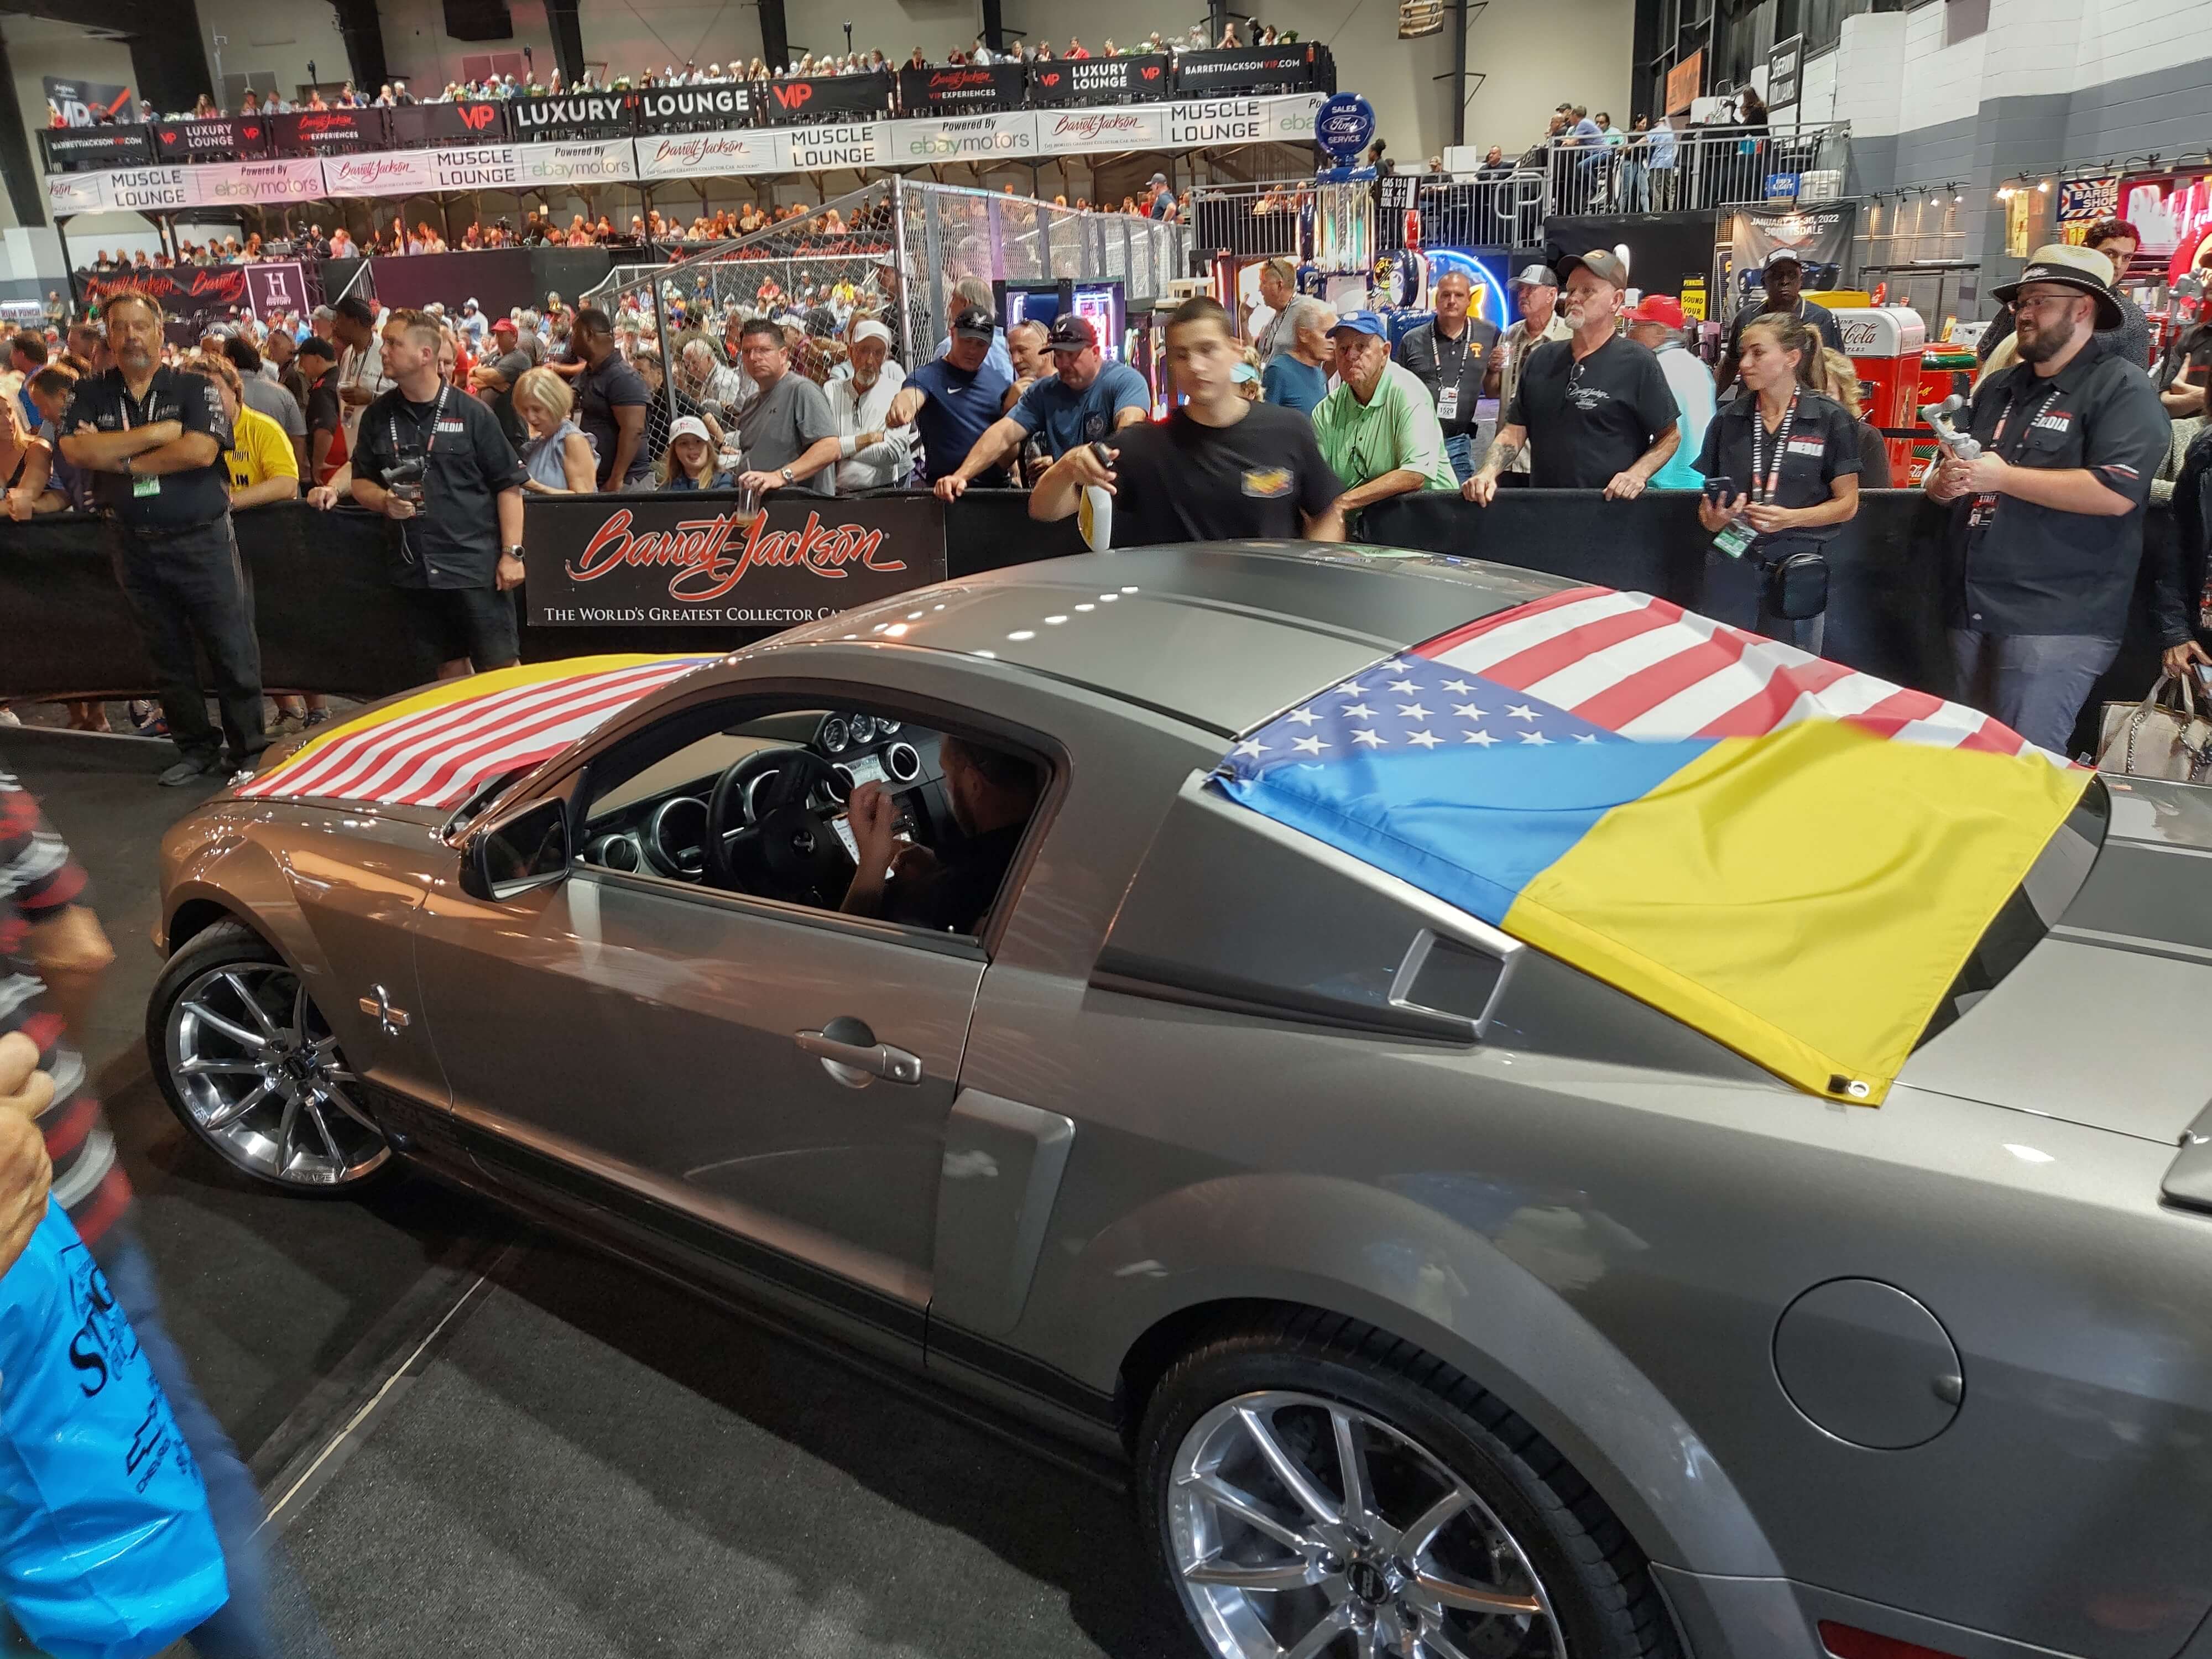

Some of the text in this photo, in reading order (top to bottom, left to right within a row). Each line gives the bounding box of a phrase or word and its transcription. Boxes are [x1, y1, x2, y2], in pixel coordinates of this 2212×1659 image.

[1072, 63, 1128, 79] LUXURY
[1141, 66, 1160, 80] VIP
[1185, 59, 1300, 75] BARRETTJACKSONVIP.COM
[1041, 73, 1061, 87] VIP
[1073, 76, 1128, 90] LOUNGE
[773, 84, 812, 109] VIP
[929, 88, 996, 99] VIPEXPERIENCES
[517, 90, 749, 127] LUXURY LOUNGE
[1171, 101, 1260, 121] MUSCLE
[1332, 105, 1357, 113] SALES
[458, 105, 495, 131] VIP
[942, 118, 997, 132] Powered By
[1329, 117, 1358, 133] Ford
[186, 123, 232, 137] LUXURY
[1051, 114, 1144, 139] Barrett-Jackson
[1172, 122, 1260, 142] LOUNGE
[189, 133, 234, 148] LOUNGE
[791, 127, 873, 146] MUSCLE
[1328, 134, 1361, 144] SERVICE
[555, 146, 605, 158] Powered By
[654, 137, 750, 165] Barrett-Jackson
[910, 133, 1030, 156] ebaymotors
[437, 149, 513, 166] MUSCLE
[794, 147, 875, 166] LOUNGE
[241, 165, 288, 176] Powered By
[340, 159, 415, 183] Barrett-Jackson
[440, 168, 515, 186] LOUNGE
[532, 160, 630, 180] ebaymotors
[111, 170, 182, 188] MUSCLE
[1382, 178, 1394, 187] GAS
[215, 177, 319, 198] ebaymotors
[1382, 188, 1393, 197] TAX
[2075, 187, 2118, 200] BARBE
[114, 189, 186, 207] LOUNGE
[2083, 196, 2118, 208] SHOP
[1750, 217, 1787, 227] JANUARY
[1818, 214, 1840, 223] 2022
[1764, 225, 1824, 236] SCOTTSDALE
[1683, 296, 1703, 304] SOUND
[1683, 306, 1701, 315] YOUR
[437, 422, 464, 432] MEDIA
[1979, 495, 1996, 503] STAFF
[565, 508, 907, 602] Barrett-Jackson
[544, 607, 575, 621] THE
[578, 607, 645, 621] WORLD'S
[649, 607, 722, 621] GREATEST
[726, 607, 815, 621] COLLECTOR
